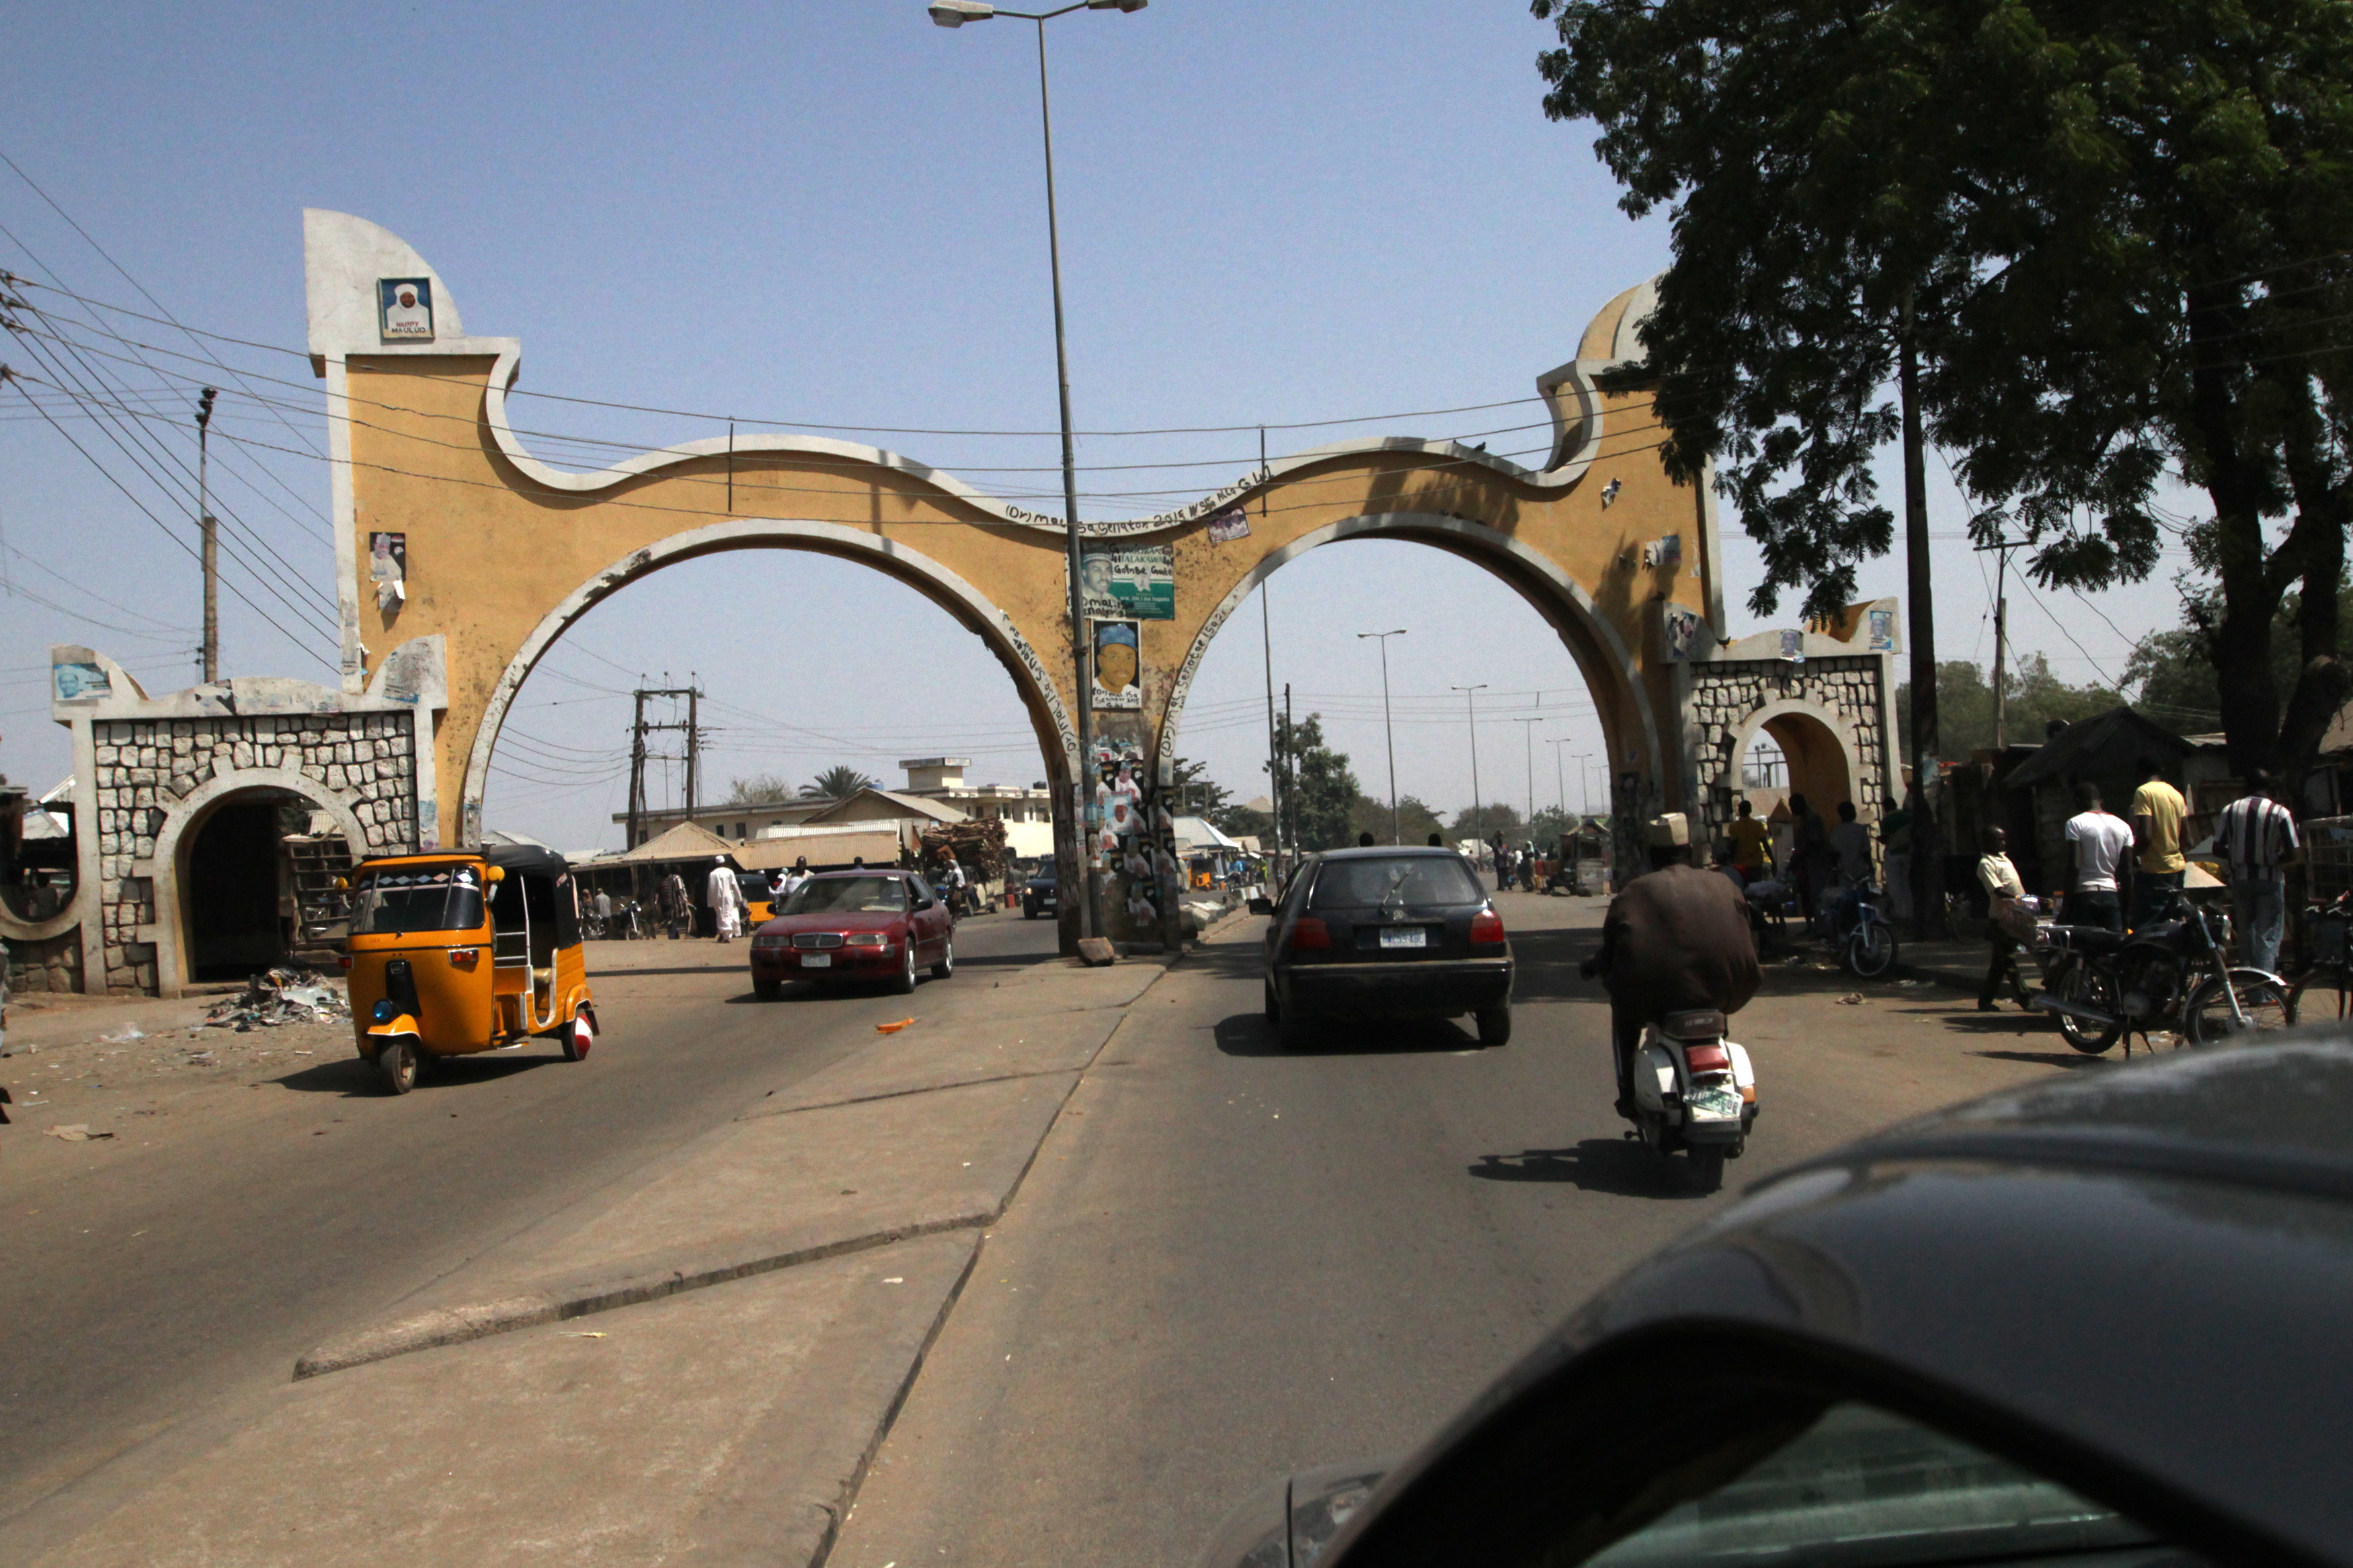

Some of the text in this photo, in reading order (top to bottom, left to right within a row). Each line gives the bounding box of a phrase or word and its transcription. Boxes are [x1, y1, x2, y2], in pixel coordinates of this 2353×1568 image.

[1006, 505, 1032, 522] (Dr)
[1077, 521, 1096, 534] Sa
[1153, 509, 1186, 527] 2015
